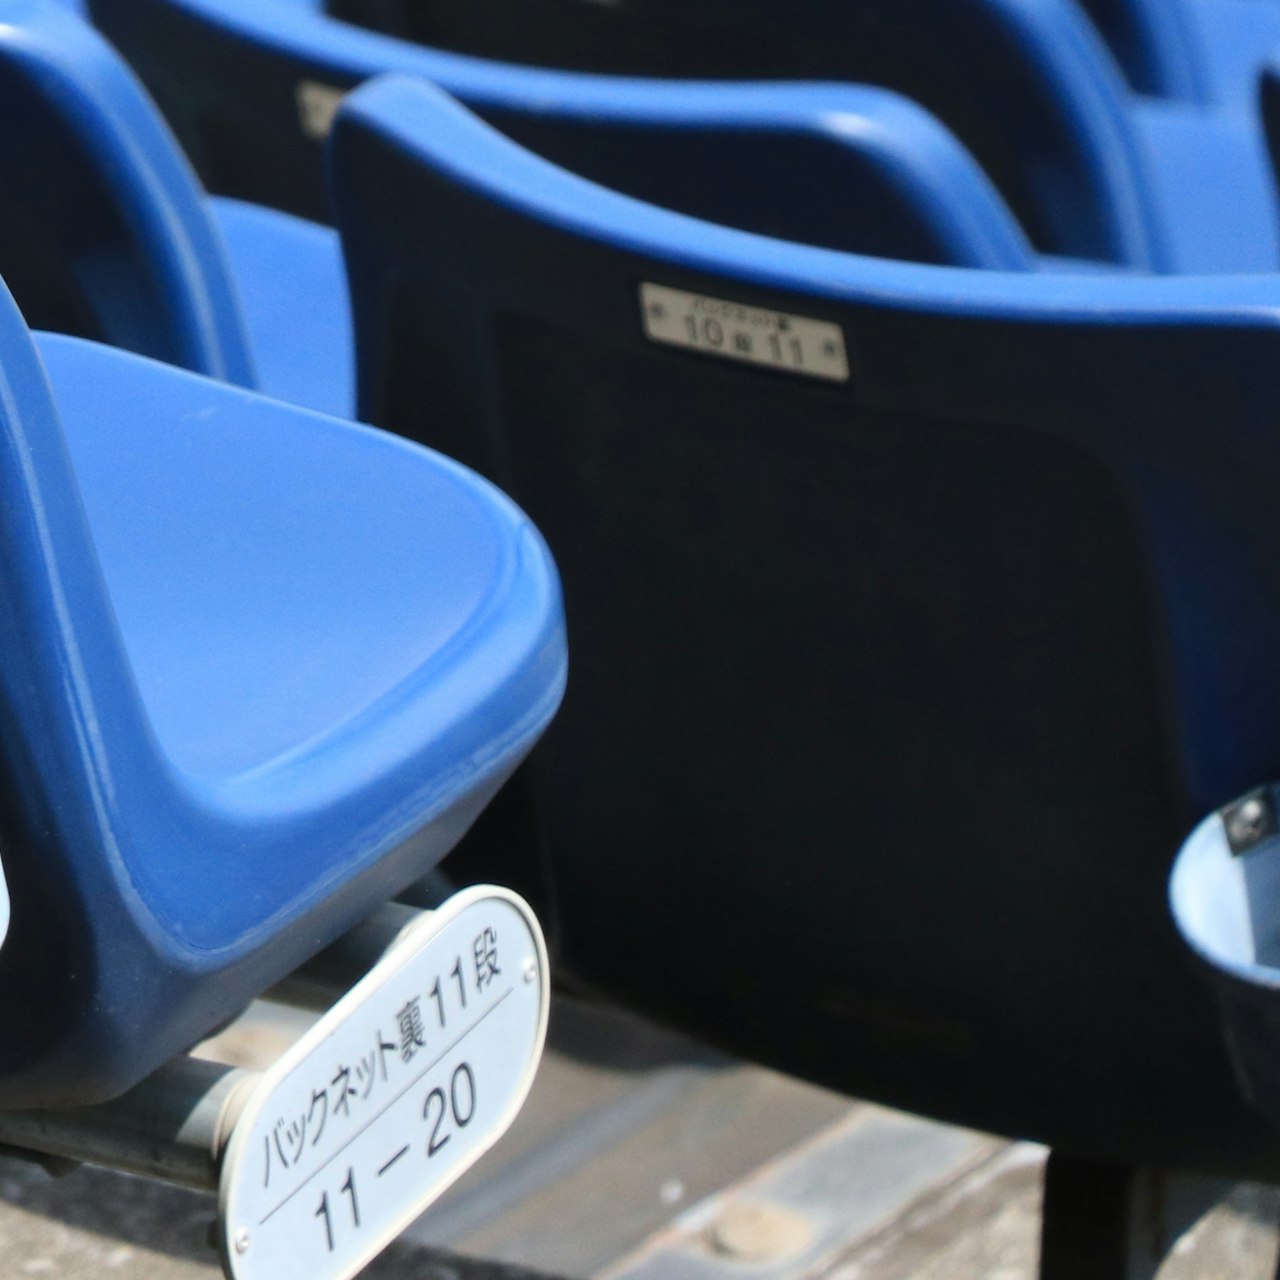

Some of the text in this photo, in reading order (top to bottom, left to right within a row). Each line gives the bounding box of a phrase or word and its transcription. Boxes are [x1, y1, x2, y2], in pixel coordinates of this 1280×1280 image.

[263, 926, 502, 1189] バックネット裏11段
